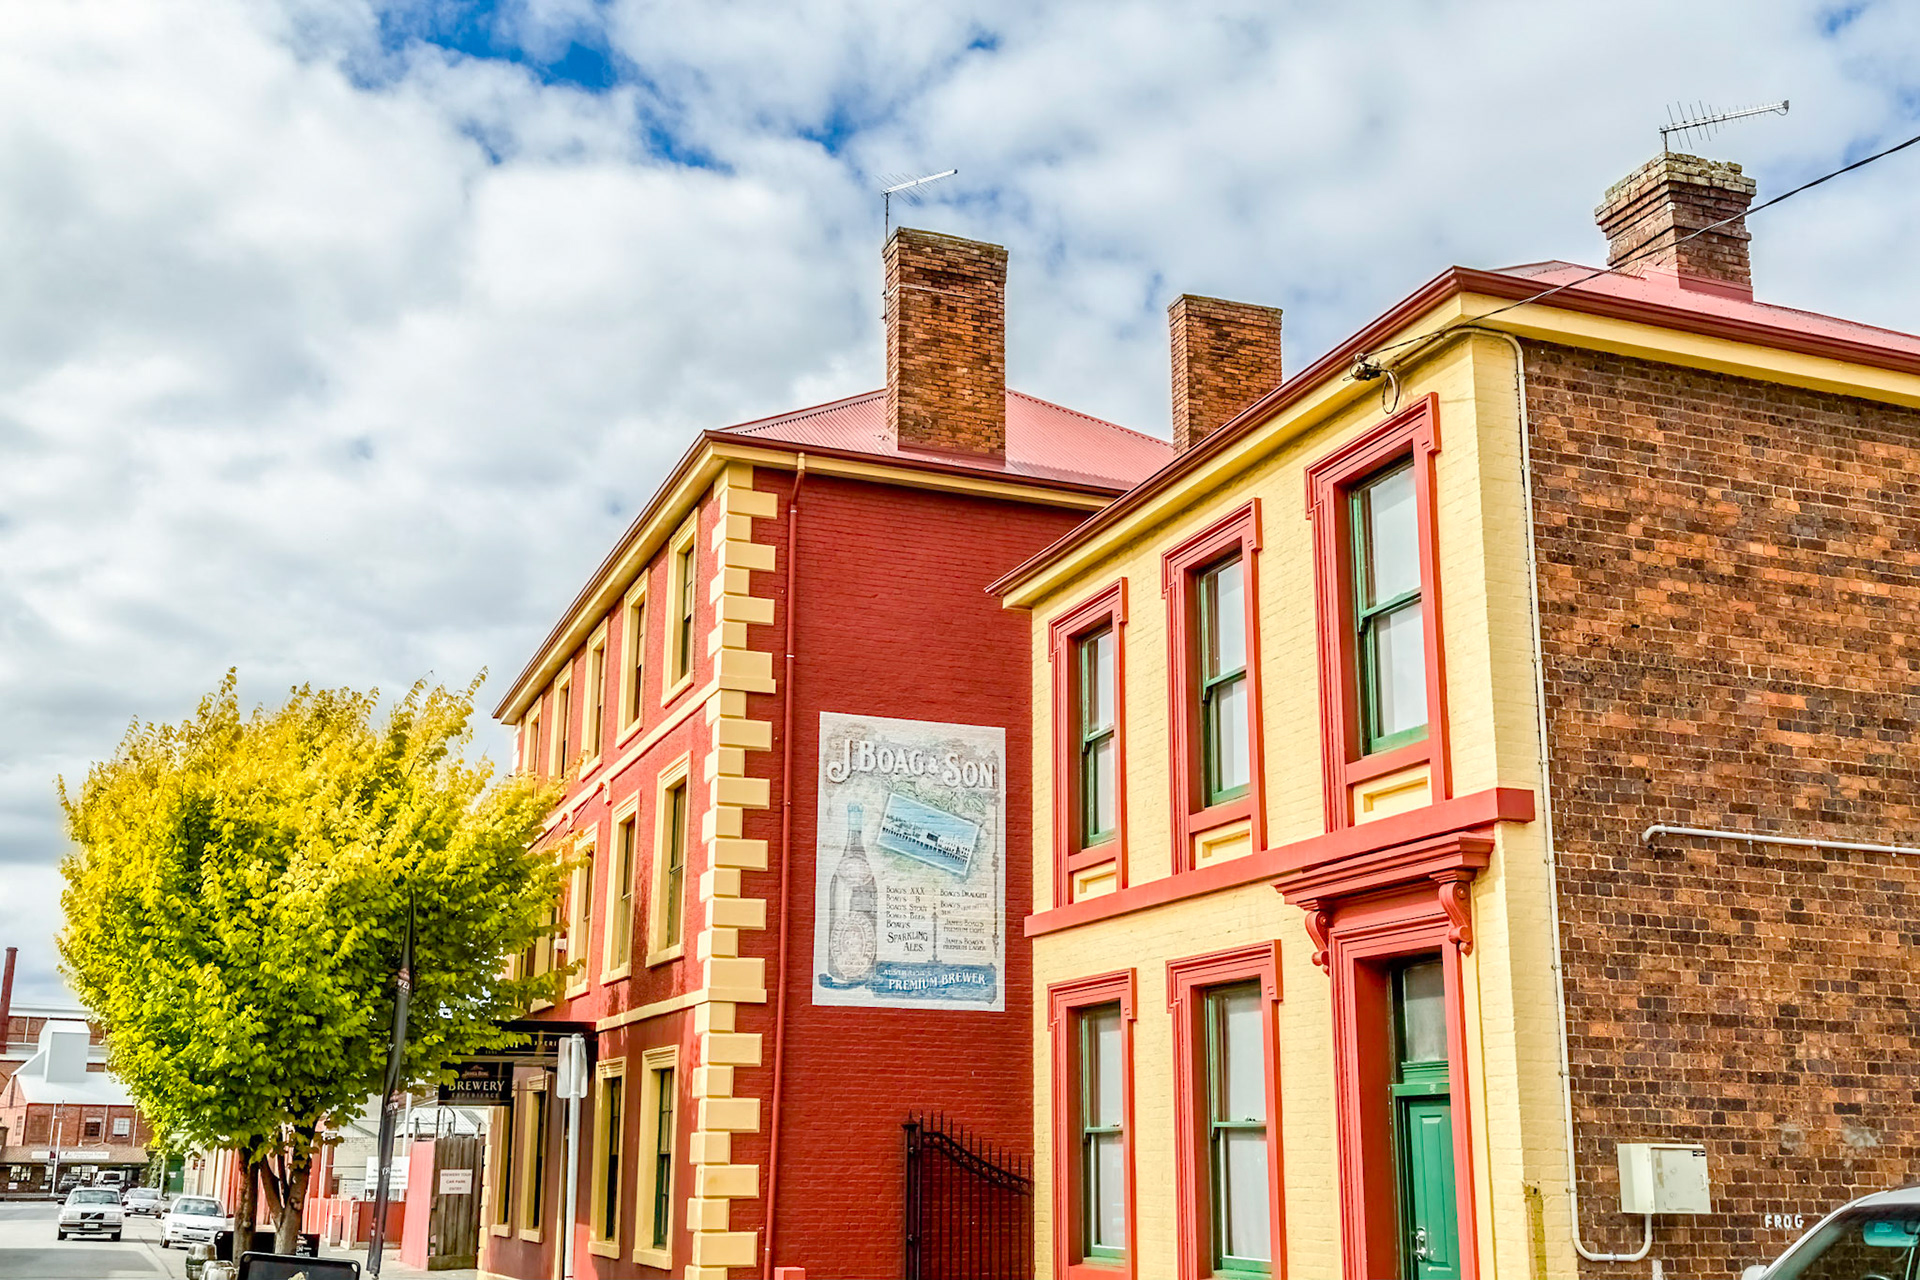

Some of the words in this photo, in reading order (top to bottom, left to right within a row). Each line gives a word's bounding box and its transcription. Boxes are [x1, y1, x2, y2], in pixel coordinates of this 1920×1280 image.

[928, 757, 939, 775] &
[942, 752, 995, 788] SON
[910, 887, 925, 895] XXX
[886, 931, 928, 944] SPARKLING
[888, 976, 938, 991] PREMIUM
[941, 972, 986, 986] BREWER
[448, 1080, 506, 1092] BREWERY
[451, 1091, 500, 1099] EXPERIENCE
[1764, 1214, 1805, 1229] FROG
